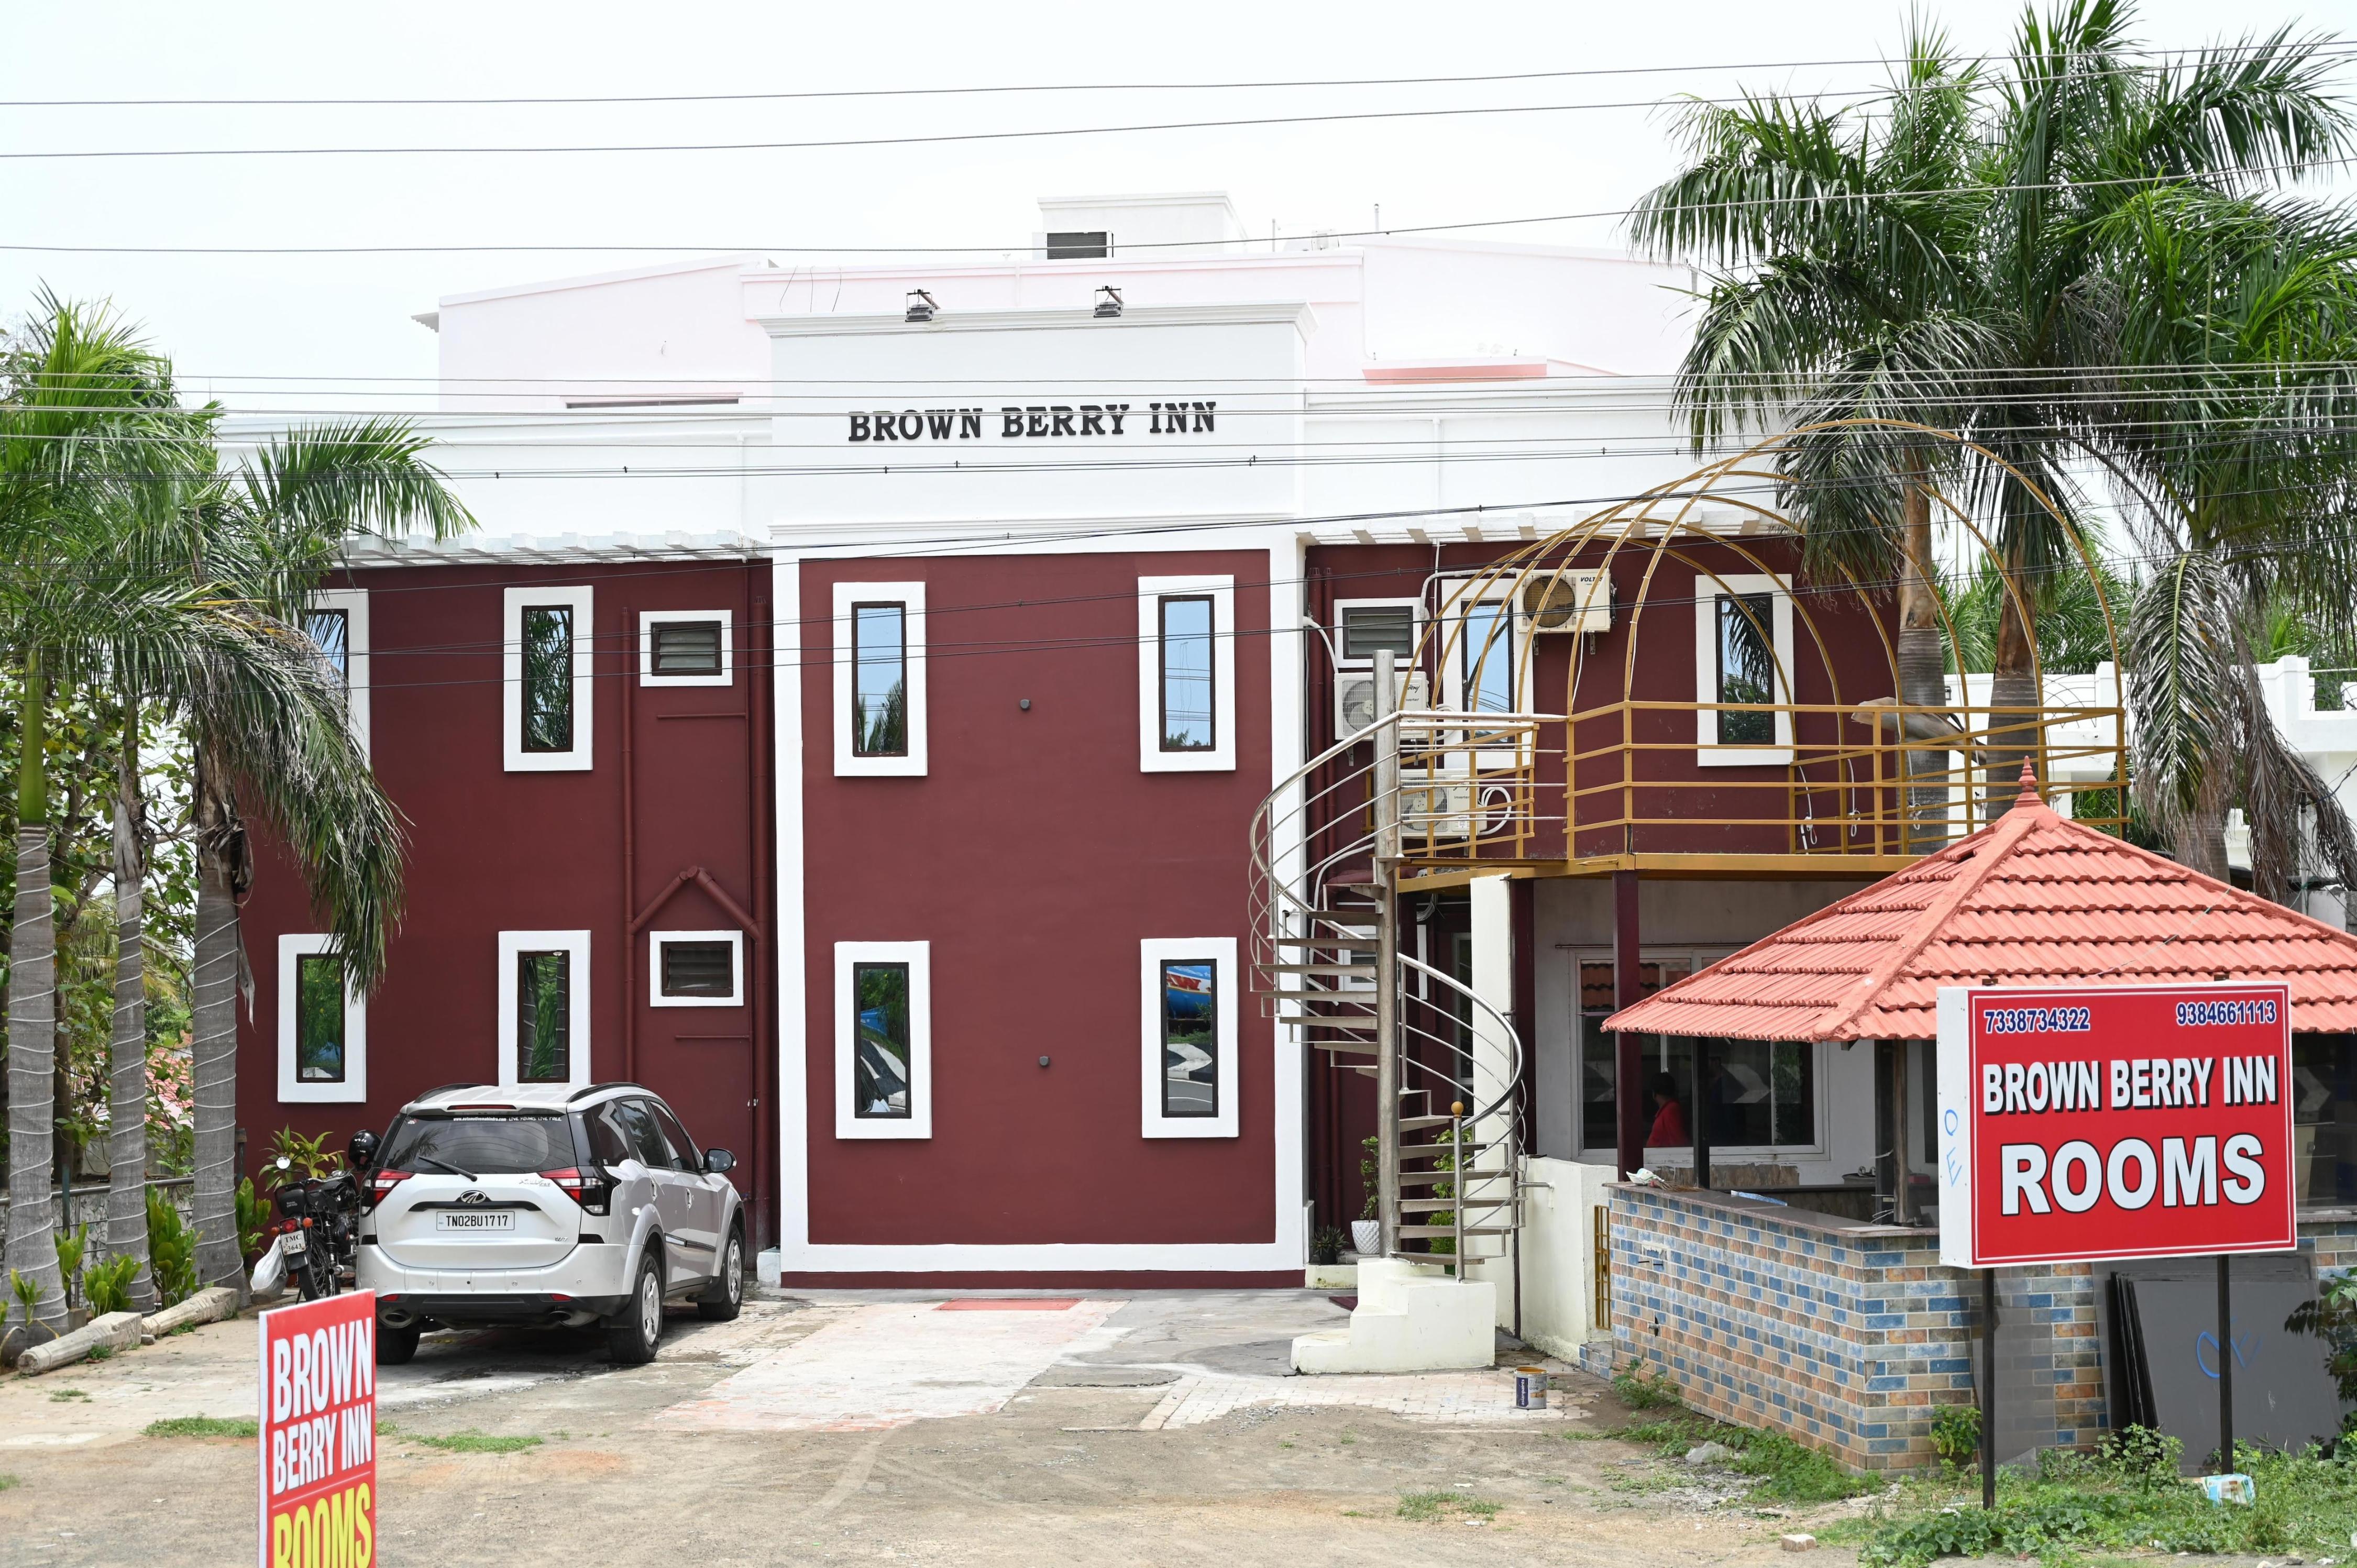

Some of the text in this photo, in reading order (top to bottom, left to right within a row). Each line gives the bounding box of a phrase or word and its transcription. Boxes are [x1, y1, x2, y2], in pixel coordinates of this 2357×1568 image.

[849, 401, 1216, 441] BROWN BERRY INN
[1984, 1007, 2091, 1034] 7338734322
[2176, 1000, 2276, 1026] 9384661113
[1982, 1055, 2278, 1115] BROWN BERRY INN
[2001, 1133, 2266, 1216] ROOMS
[446, 1215, 508, 1227] TN02BU1717
[284, 1234, 302, 1243] TMC
[287, 1243, 302, 1252] 3643
[273, 1317, 372, 1424] BROWN
[273, 1401, 372, 1496] BERRY INN
